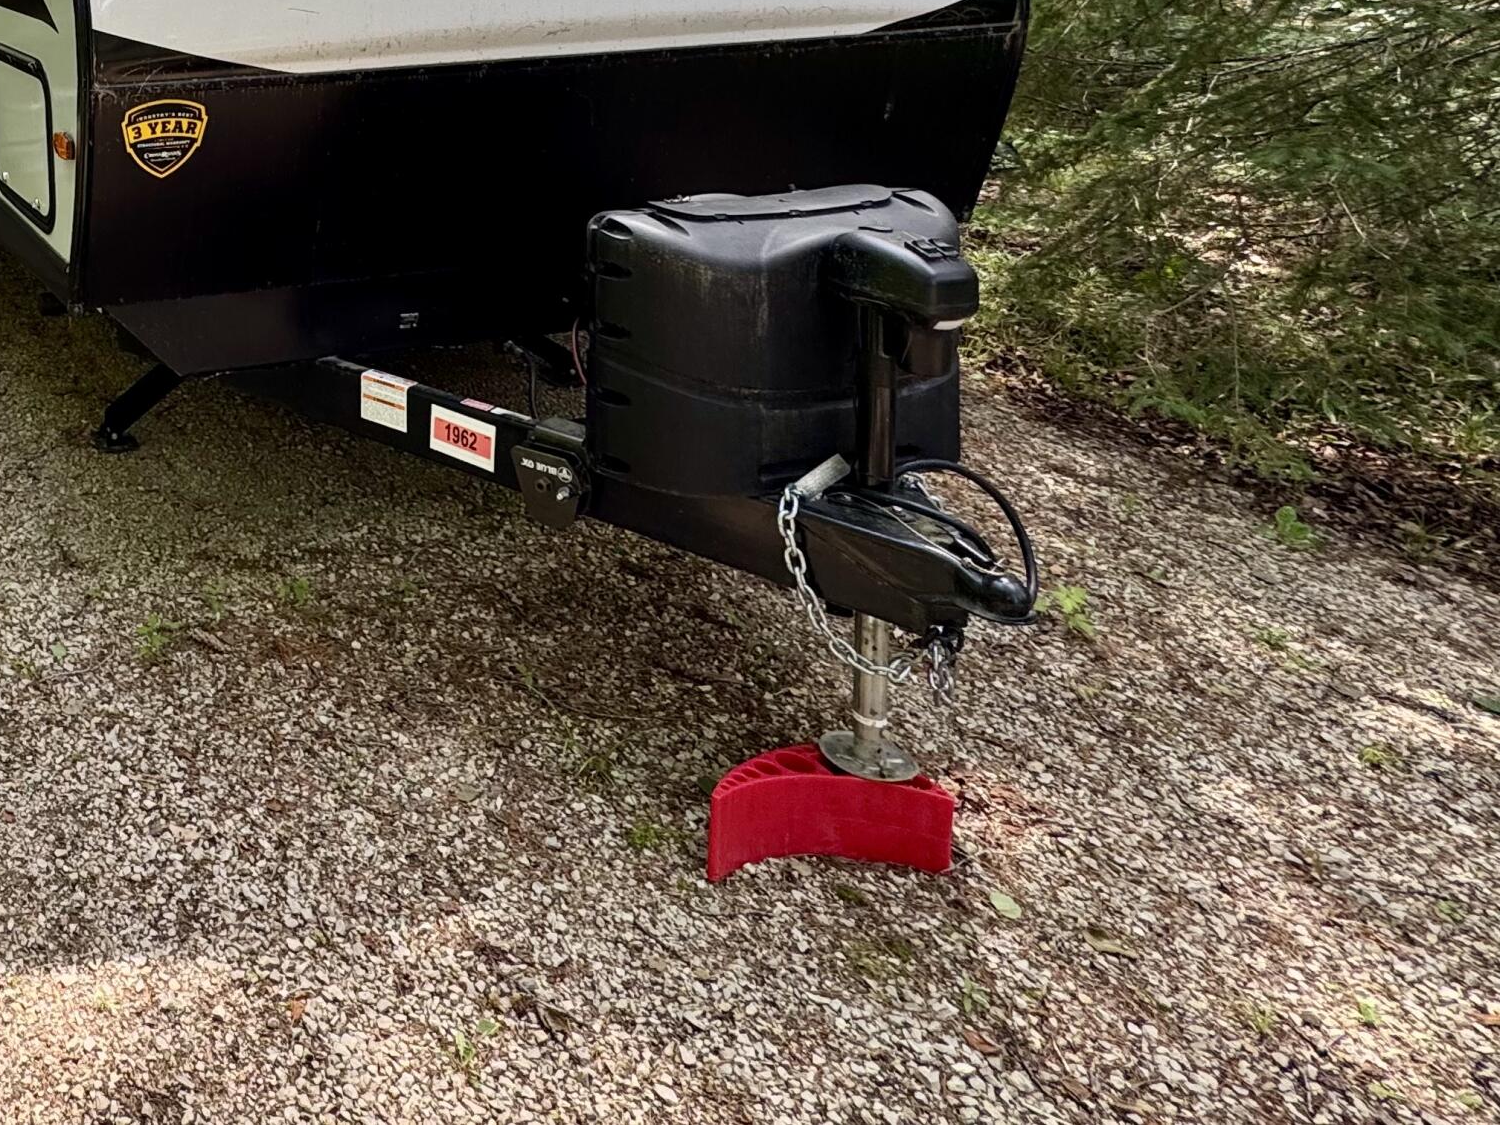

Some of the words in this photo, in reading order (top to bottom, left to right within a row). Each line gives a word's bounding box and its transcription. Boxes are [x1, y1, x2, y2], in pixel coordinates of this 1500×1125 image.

[131, 126, 142, 140] 3
[148, 121, 197, 135] YEAR
[444, 423, 478, 451] 1962
